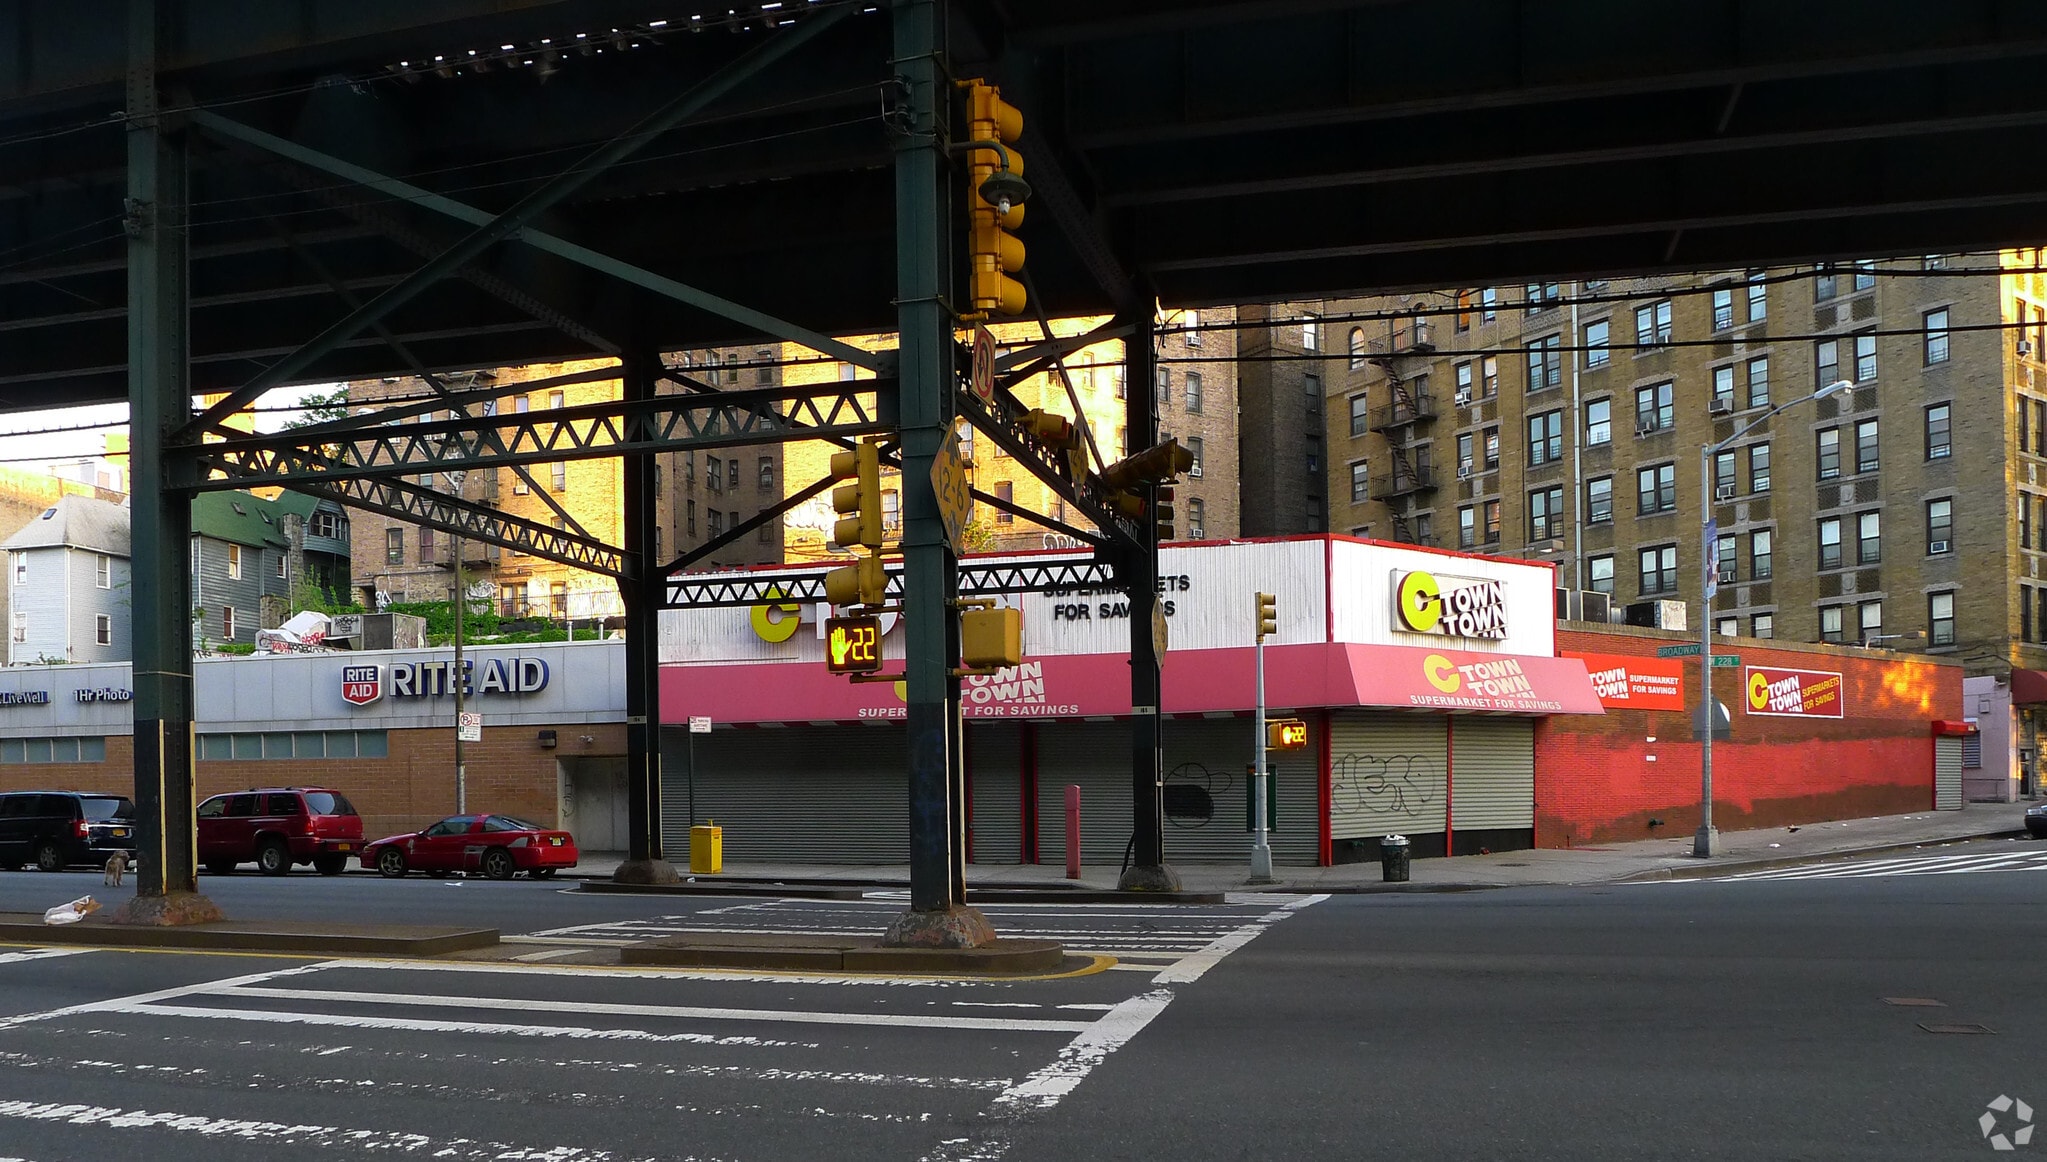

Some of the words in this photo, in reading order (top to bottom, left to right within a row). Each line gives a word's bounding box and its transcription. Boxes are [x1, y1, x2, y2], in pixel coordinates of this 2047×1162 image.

[1440, 580, 1506, 616] TOWN
[1054, 603, 1090, 621] FOR
[1100, 601, 1175, 619] SAVS
[1439, 602, 1509, 637] TOWN
[852, 627, 875, 660] 22
[1658, 645, 1700, 656] BROADWAY
[1457, 658, 1523, 681] TOWN
[1718, 657, 1732, 666] 228
[346, 667, 375, 682] RITE
[389, 661, 471, 697] RITE
[478, 658, 549, 693] AID
[1629, 674, 1679, 685] SUPERMARKET
[73, 689, 94, 702] 1Hr
[96, 688, 131, 701] Photo
[349, 683, 373, 698] AID
[1467, 675, 1531, 696] TOWN
[1632, 685, 1646, 693] FOR
[1648, 686, 1677, 695] SAVINGS
[1767, 675, 1800, 698] TOWN
[1802, 676, 1840, 698] SUPERMARKETS
[858, 707, 970, 717] SUPERT
[975, 706, 1004, 716] FOR
[1010, 704, 1079, 715] SAVINGS
[1410, 695, 1491, 708] SUPERMARKET
[1495, 698, 1516, 709] FOR
[1518, 700, 1562, 710] SAVINGS
[1769, 690, 1802, 711] TOWN
[1803, 700, 1814, 711] FOR
[1815, 691, 1836, 706] SAVINGS
